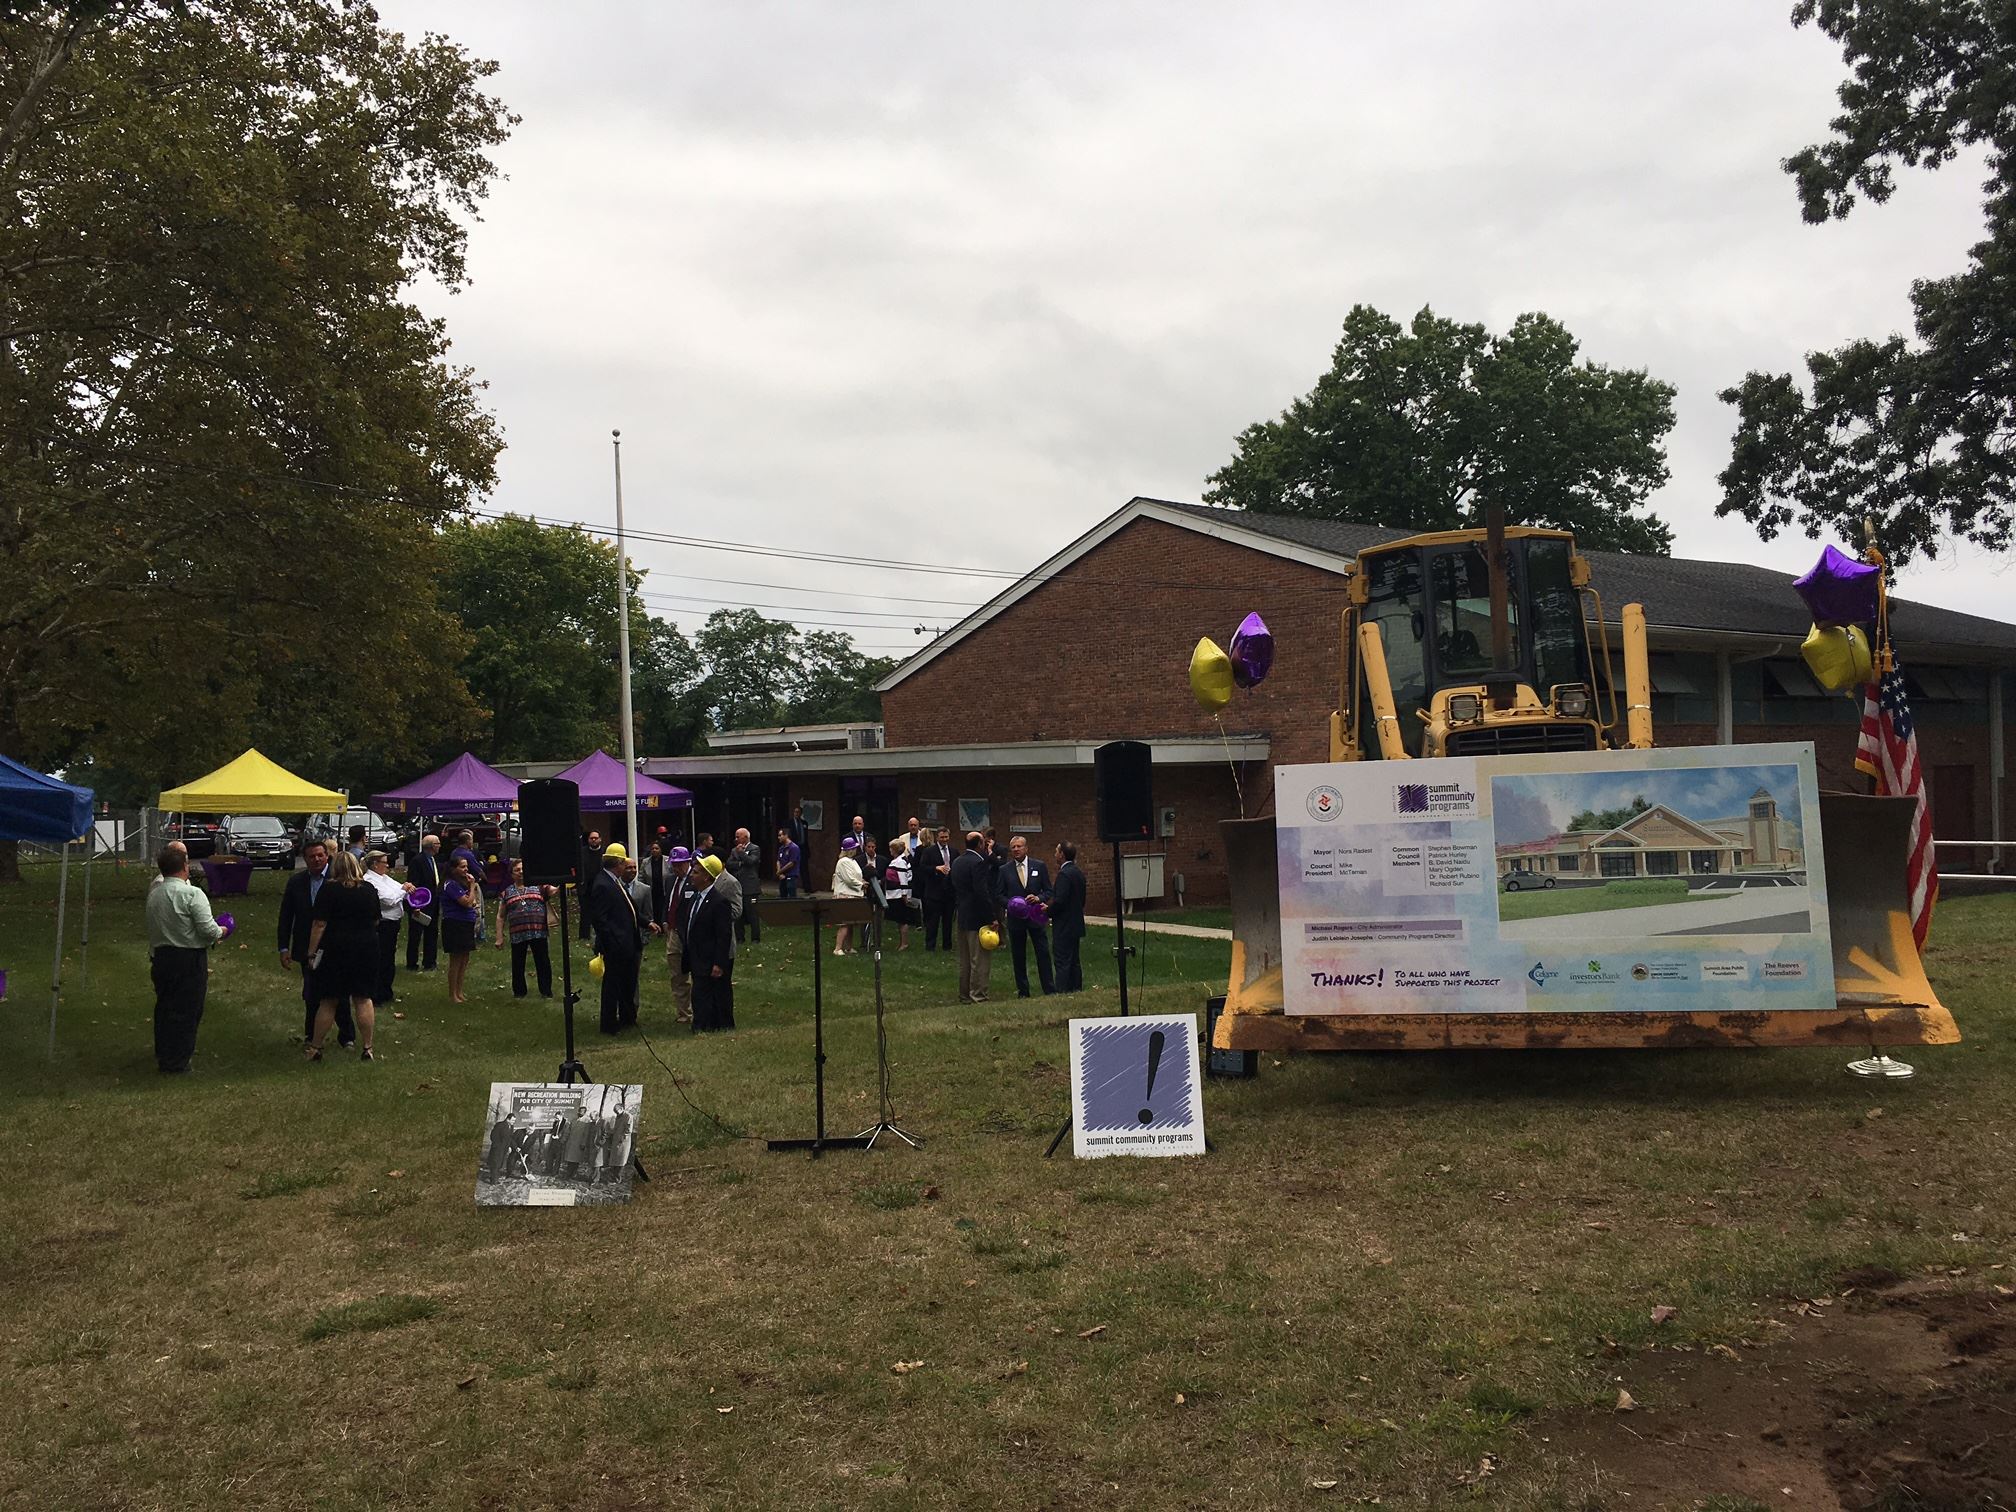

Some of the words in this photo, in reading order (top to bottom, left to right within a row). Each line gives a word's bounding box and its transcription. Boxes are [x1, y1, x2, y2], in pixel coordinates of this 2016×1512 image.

[1429, 782, 1460, 792] summit
[1429, 792, 1474, 802] community
[1430, 802, 1470, 812] programs
[1087, 1136, 1113, 1145] summit
[1116, 1134, 1156, 1144] community
[1158, 1134, 1193, 1144] programs
